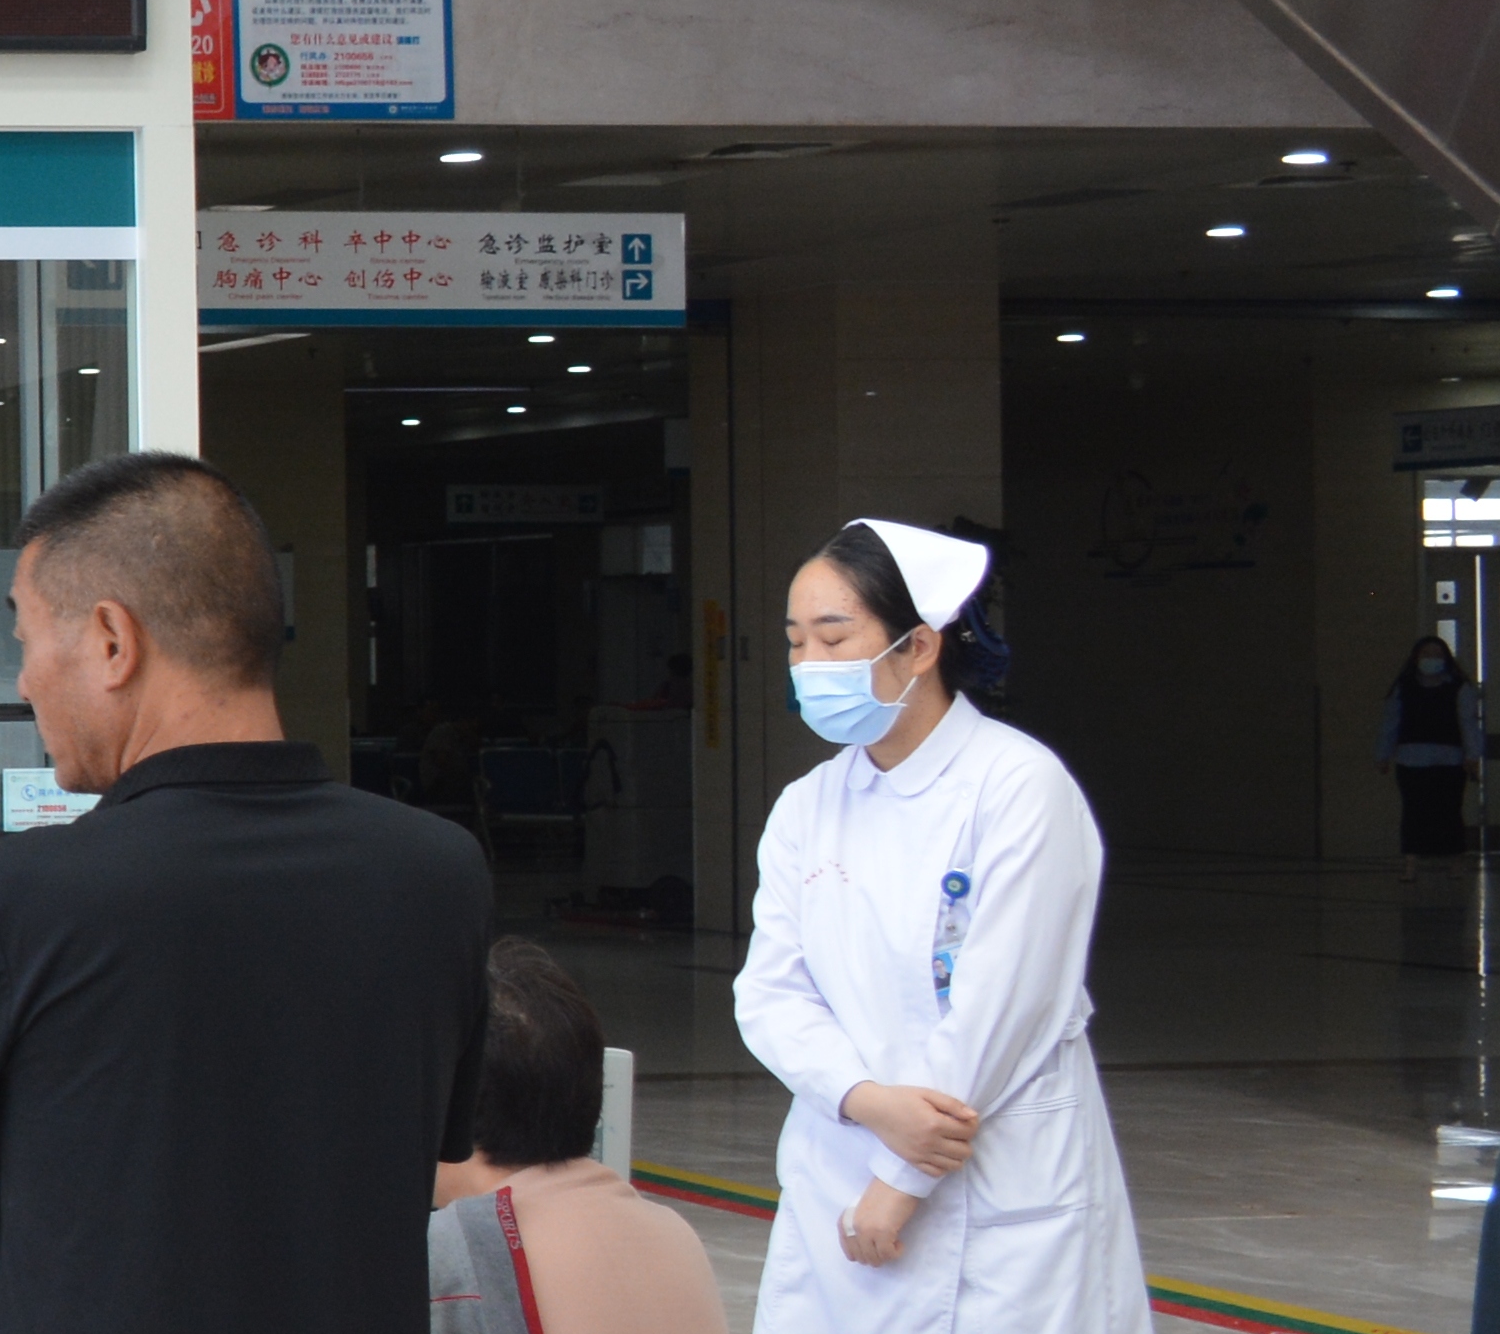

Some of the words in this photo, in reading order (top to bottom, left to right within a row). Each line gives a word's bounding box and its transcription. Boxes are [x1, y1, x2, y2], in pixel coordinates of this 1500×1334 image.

[217, 230, 323, 253] 急诊科
[344, 230, 451, 253] 卒中中心
[479, 233, 612, 255] 急诊监护室
[213, 267, 322, 290] 胸痛中心
[344, 267, 453, 291] 创伤中心
